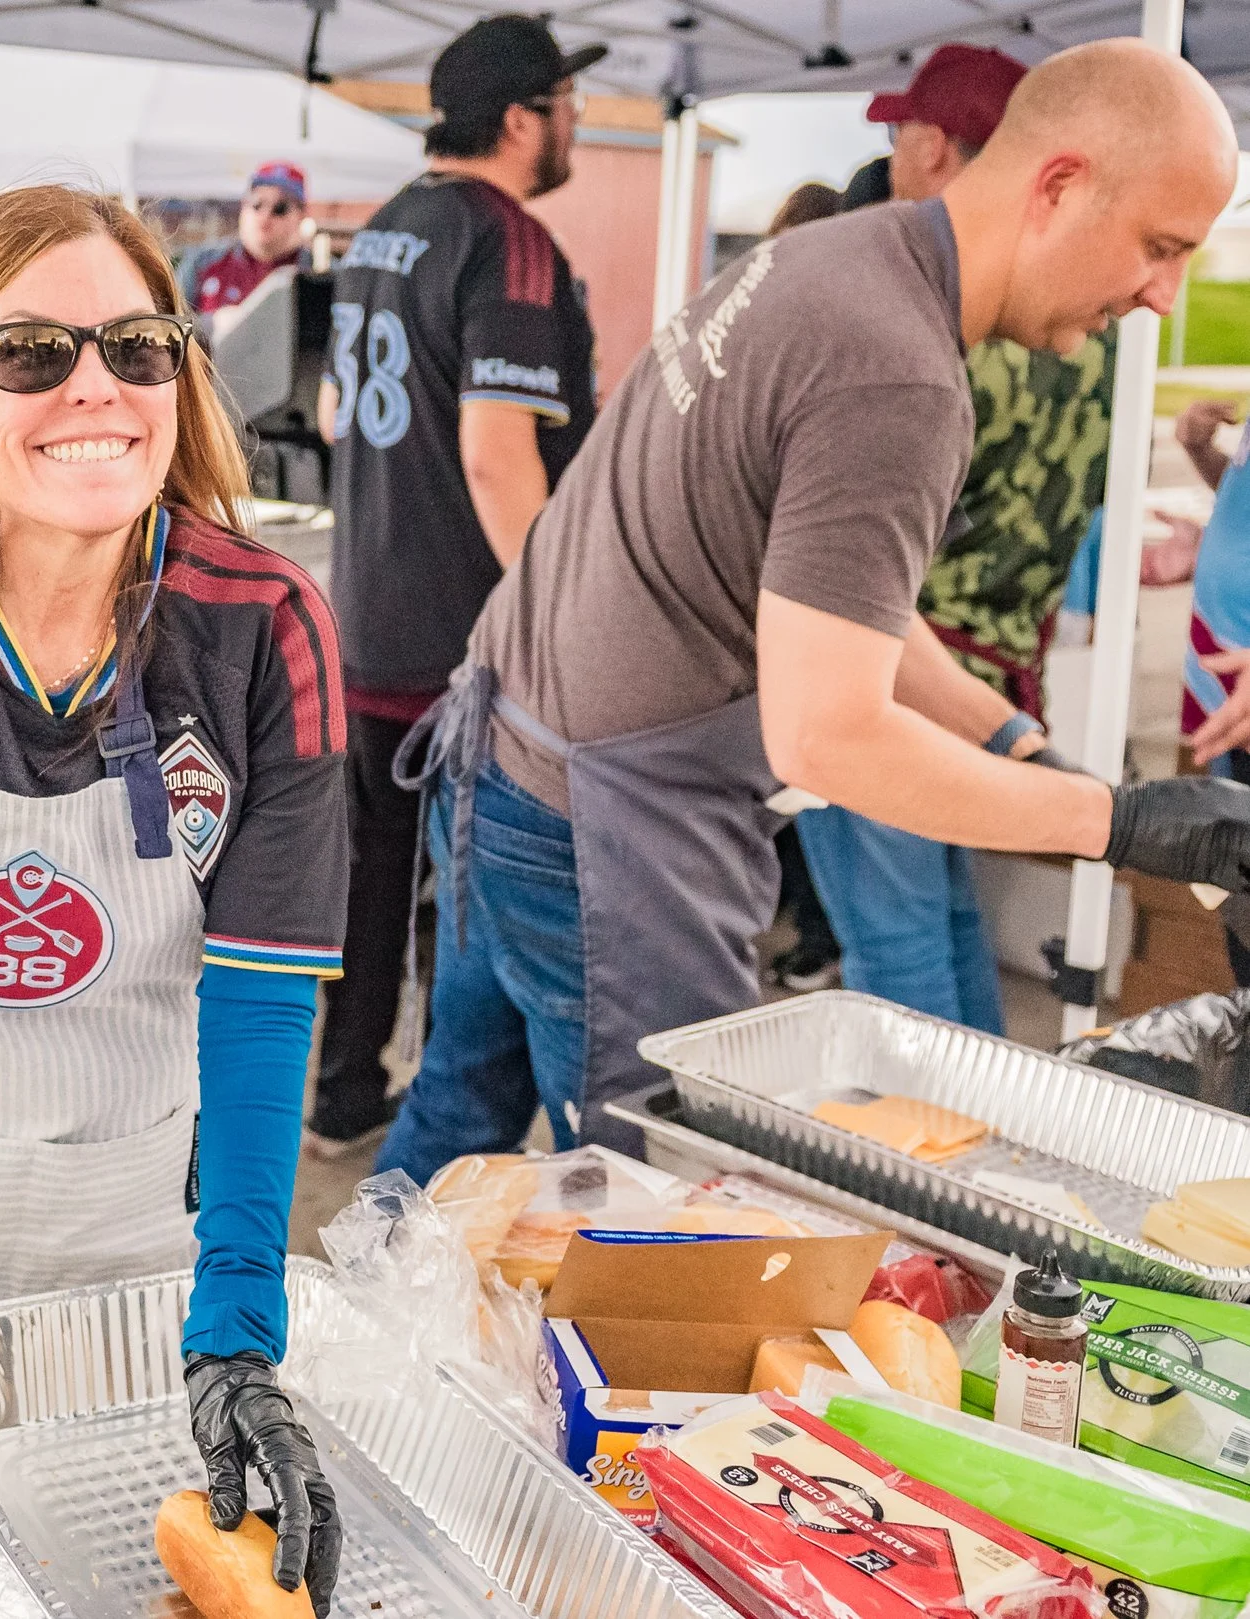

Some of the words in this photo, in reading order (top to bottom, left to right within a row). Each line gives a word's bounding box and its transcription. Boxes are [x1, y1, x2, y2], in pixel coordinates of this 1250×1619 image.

[330, 302, 412, 449] 38
[174, 788, 213, 797] RAPIDS
[1131, 1325, 1174, 1335] NATURAL
[1175, 1330, 1200, 1357] CHEESE
[1087, 1333, 1125, 1353] PPER
[1126, 1346, 1172, 1369] JACK
[1173, 1364, 1241, 1402] CHEESE
[1114, 1386, 1150, 1404] SLICES
[580, 1453, 651, 1500] Sing
[727, 1467, 749, 1482] 42
[770, 1463, 827, 1501] CHEESE
[826, 1502, 874, 1531] SWISS
[871, 1529, 918, 1557] BABY
[1113, 1591, 1140, 1613] 42
[1116, 1582, 1141, 1597] ABOUT
